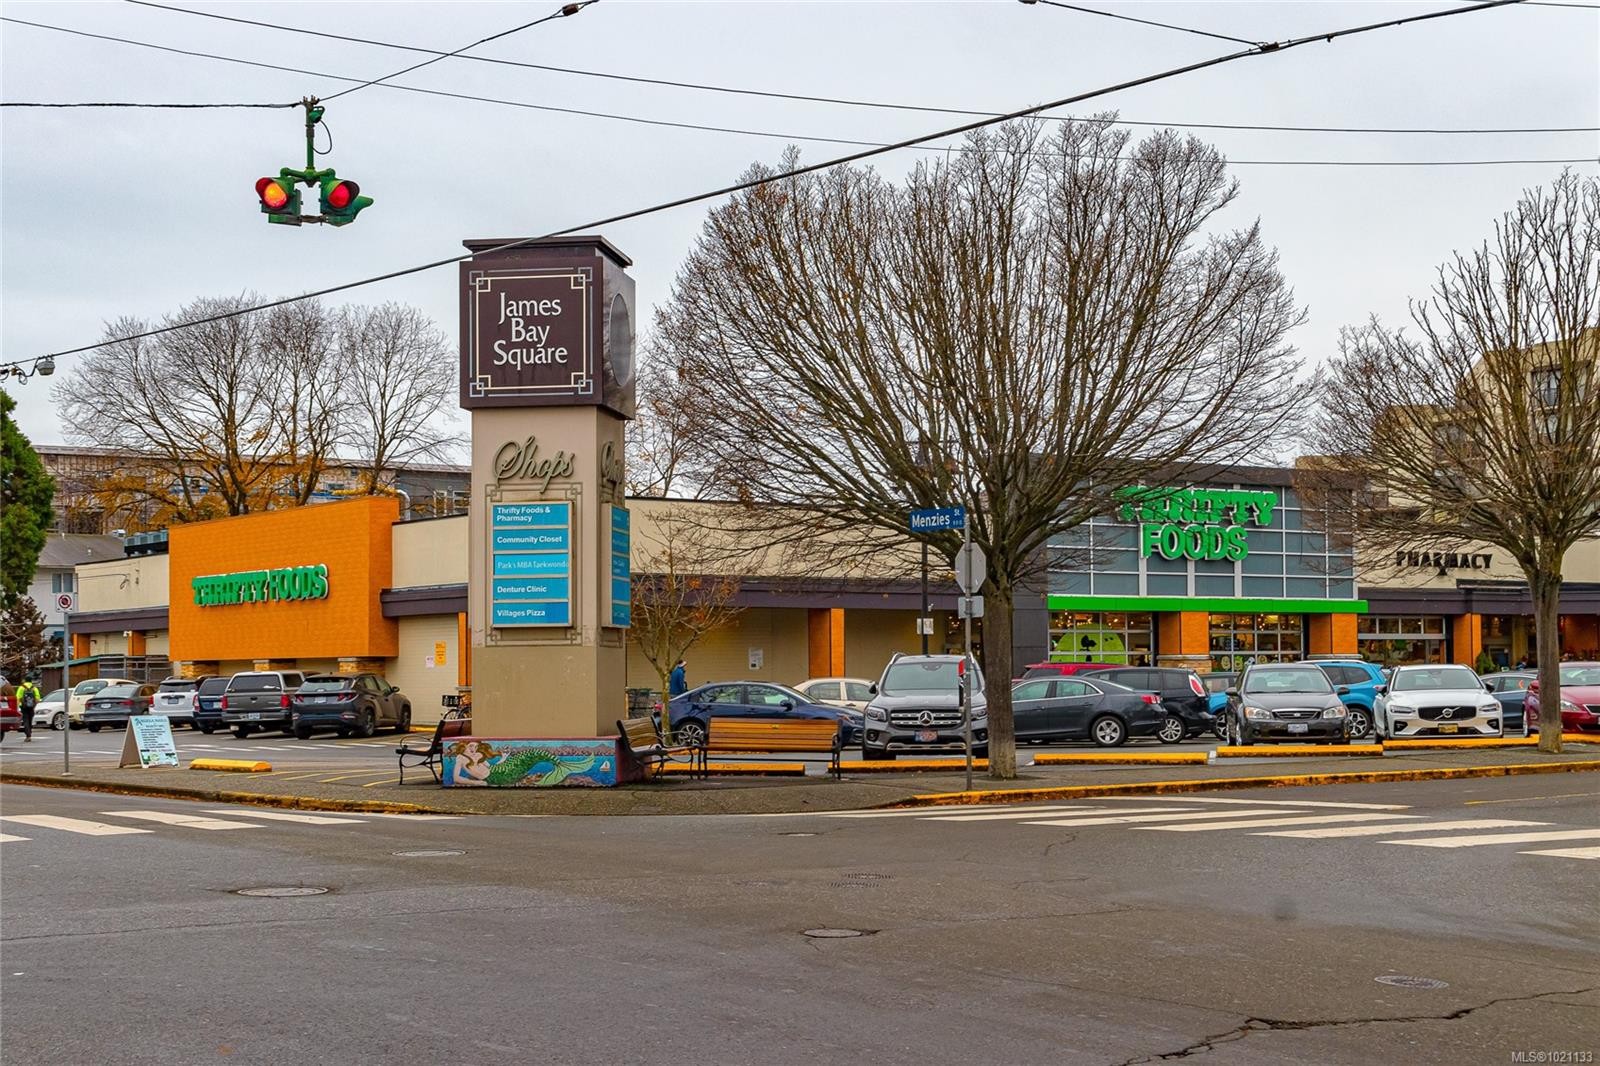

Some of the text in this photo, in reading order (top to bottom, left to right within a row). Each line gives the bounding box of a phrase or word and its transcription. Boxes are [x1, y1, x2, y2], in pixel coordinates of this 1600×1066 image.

[498, 292, 562, 325] James
[511, 318, 550, 347] Bay
[493, 340, 568, 371] Square
[494, 436, 575, 494] Shops
[497, 506, 551, 516] Thrifty Foods &
[497, 515, 532, 523] Pharmacy
[911, 513, 951, 528] Menzies
[953, 508, 961, 517] St
[497, 535, 562, 545] Community Closet
[1140, 523, 1249, 562] FOODS
[1395, 550, 1493, 569] PHARMACY
[192, 564, 328, 608] THRIFTY FOODS
[526, 585, 547, 593] Clinic
[497, 609, 546, 618] Villages Pizza
